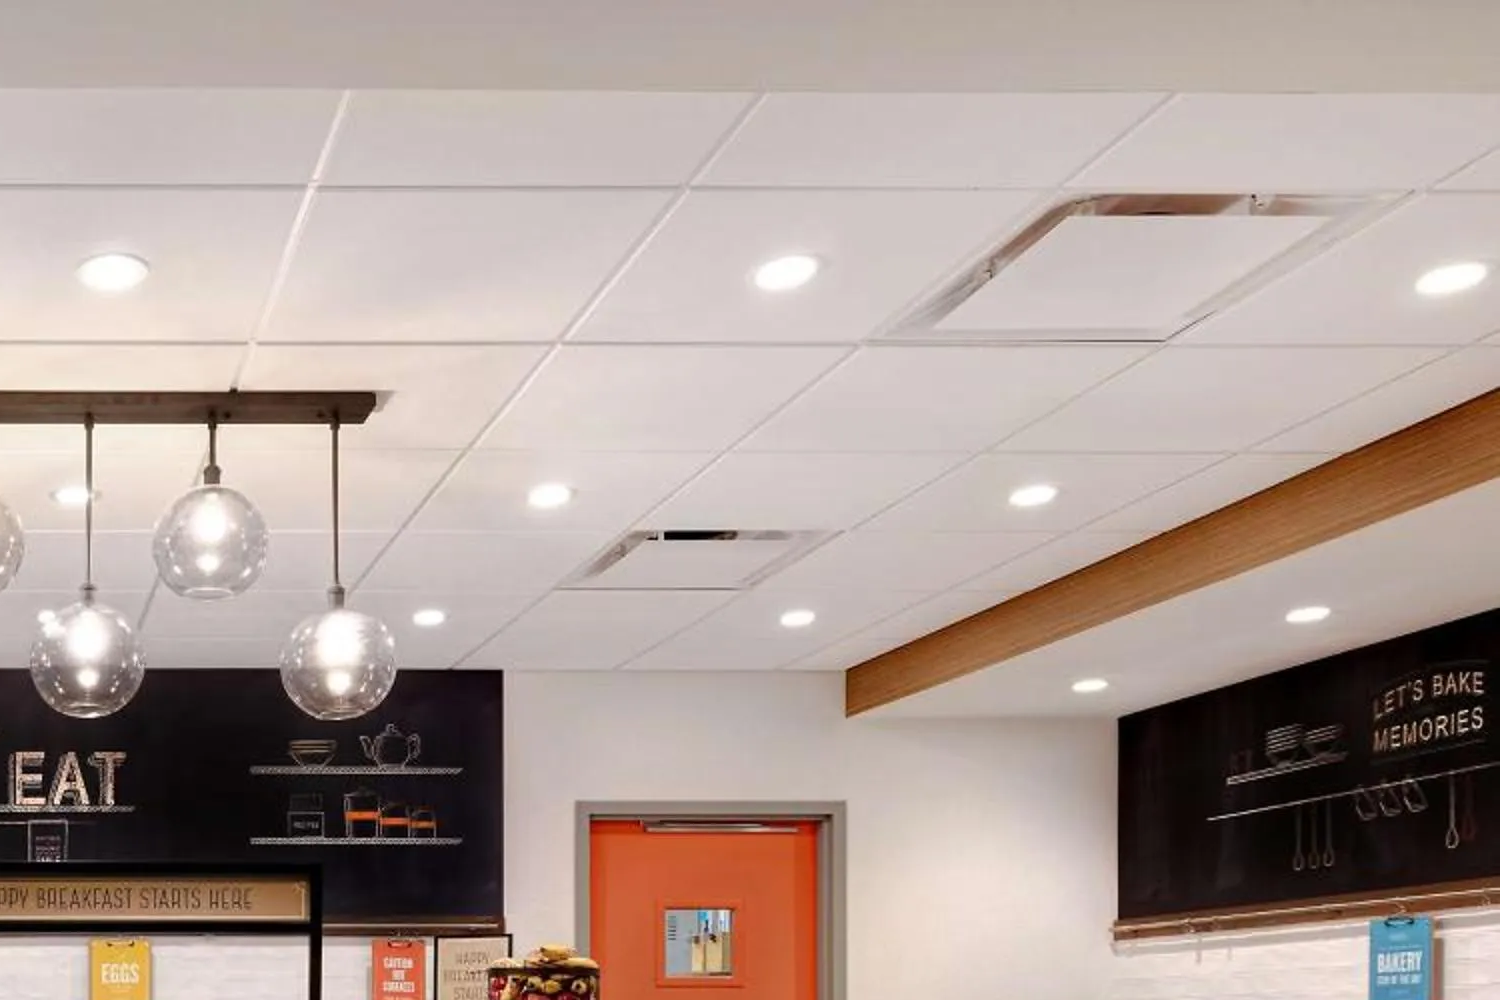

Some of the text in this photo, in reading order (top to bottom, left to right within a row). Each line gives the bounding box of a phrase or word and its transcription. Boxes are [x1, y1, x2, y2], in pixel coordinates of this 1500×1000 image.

[1373, 671, 1485, 720] LET'S BAKE
[1373, 706, 1484, 753] MEMORIES
[9, 751, 127, 806] EAT
[36, 887, 132, 909] BREAKFAST
[139, 887, 202, 909] STARTS
[209, 887, 254, 909] HERE
[101, 962, 140, 985] EGGS
[1377, 951, 1423, 974] BAKERY
